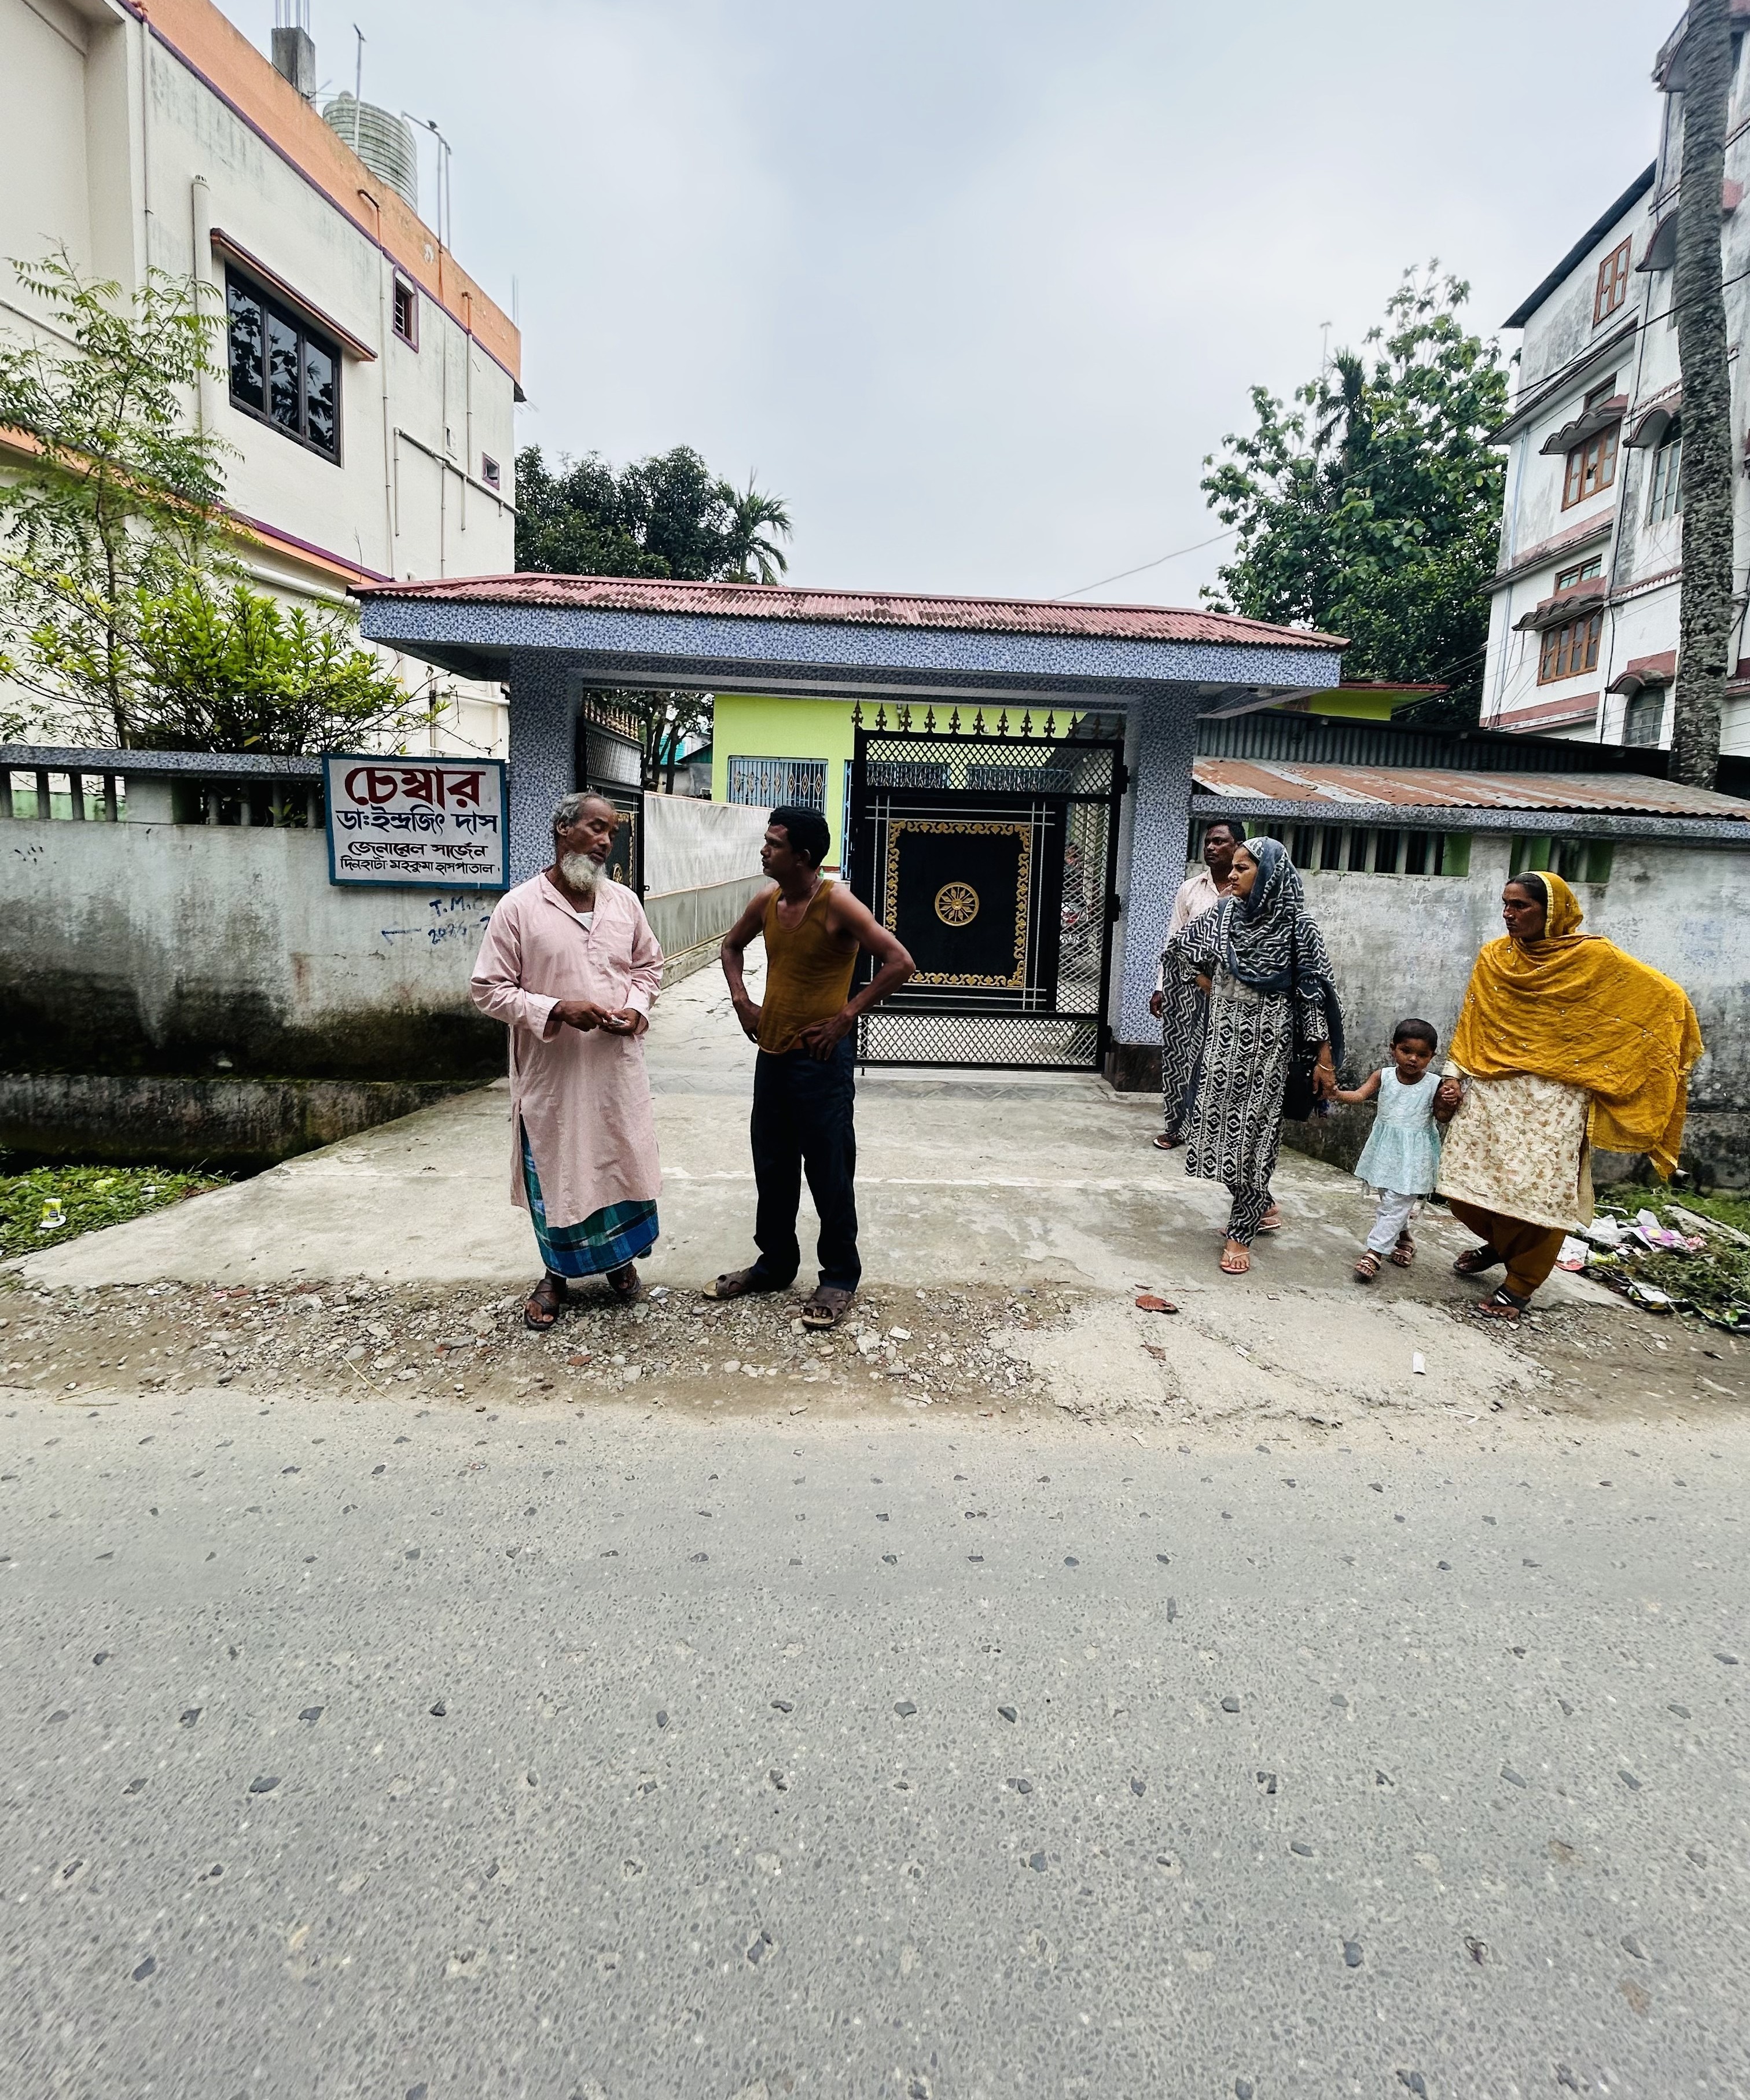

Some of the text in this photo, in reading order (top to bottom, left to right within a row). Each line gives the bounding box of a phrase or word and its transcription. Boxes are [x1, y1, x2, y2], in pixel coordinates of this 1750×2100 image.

[344, 766, 486, 810] চেম্বার
[450, 810, 498, 835] দাস
[348, 841, 488, 860] জেনারেল সার্জেন
[340, 855, 388, 871] দিনহাটা
